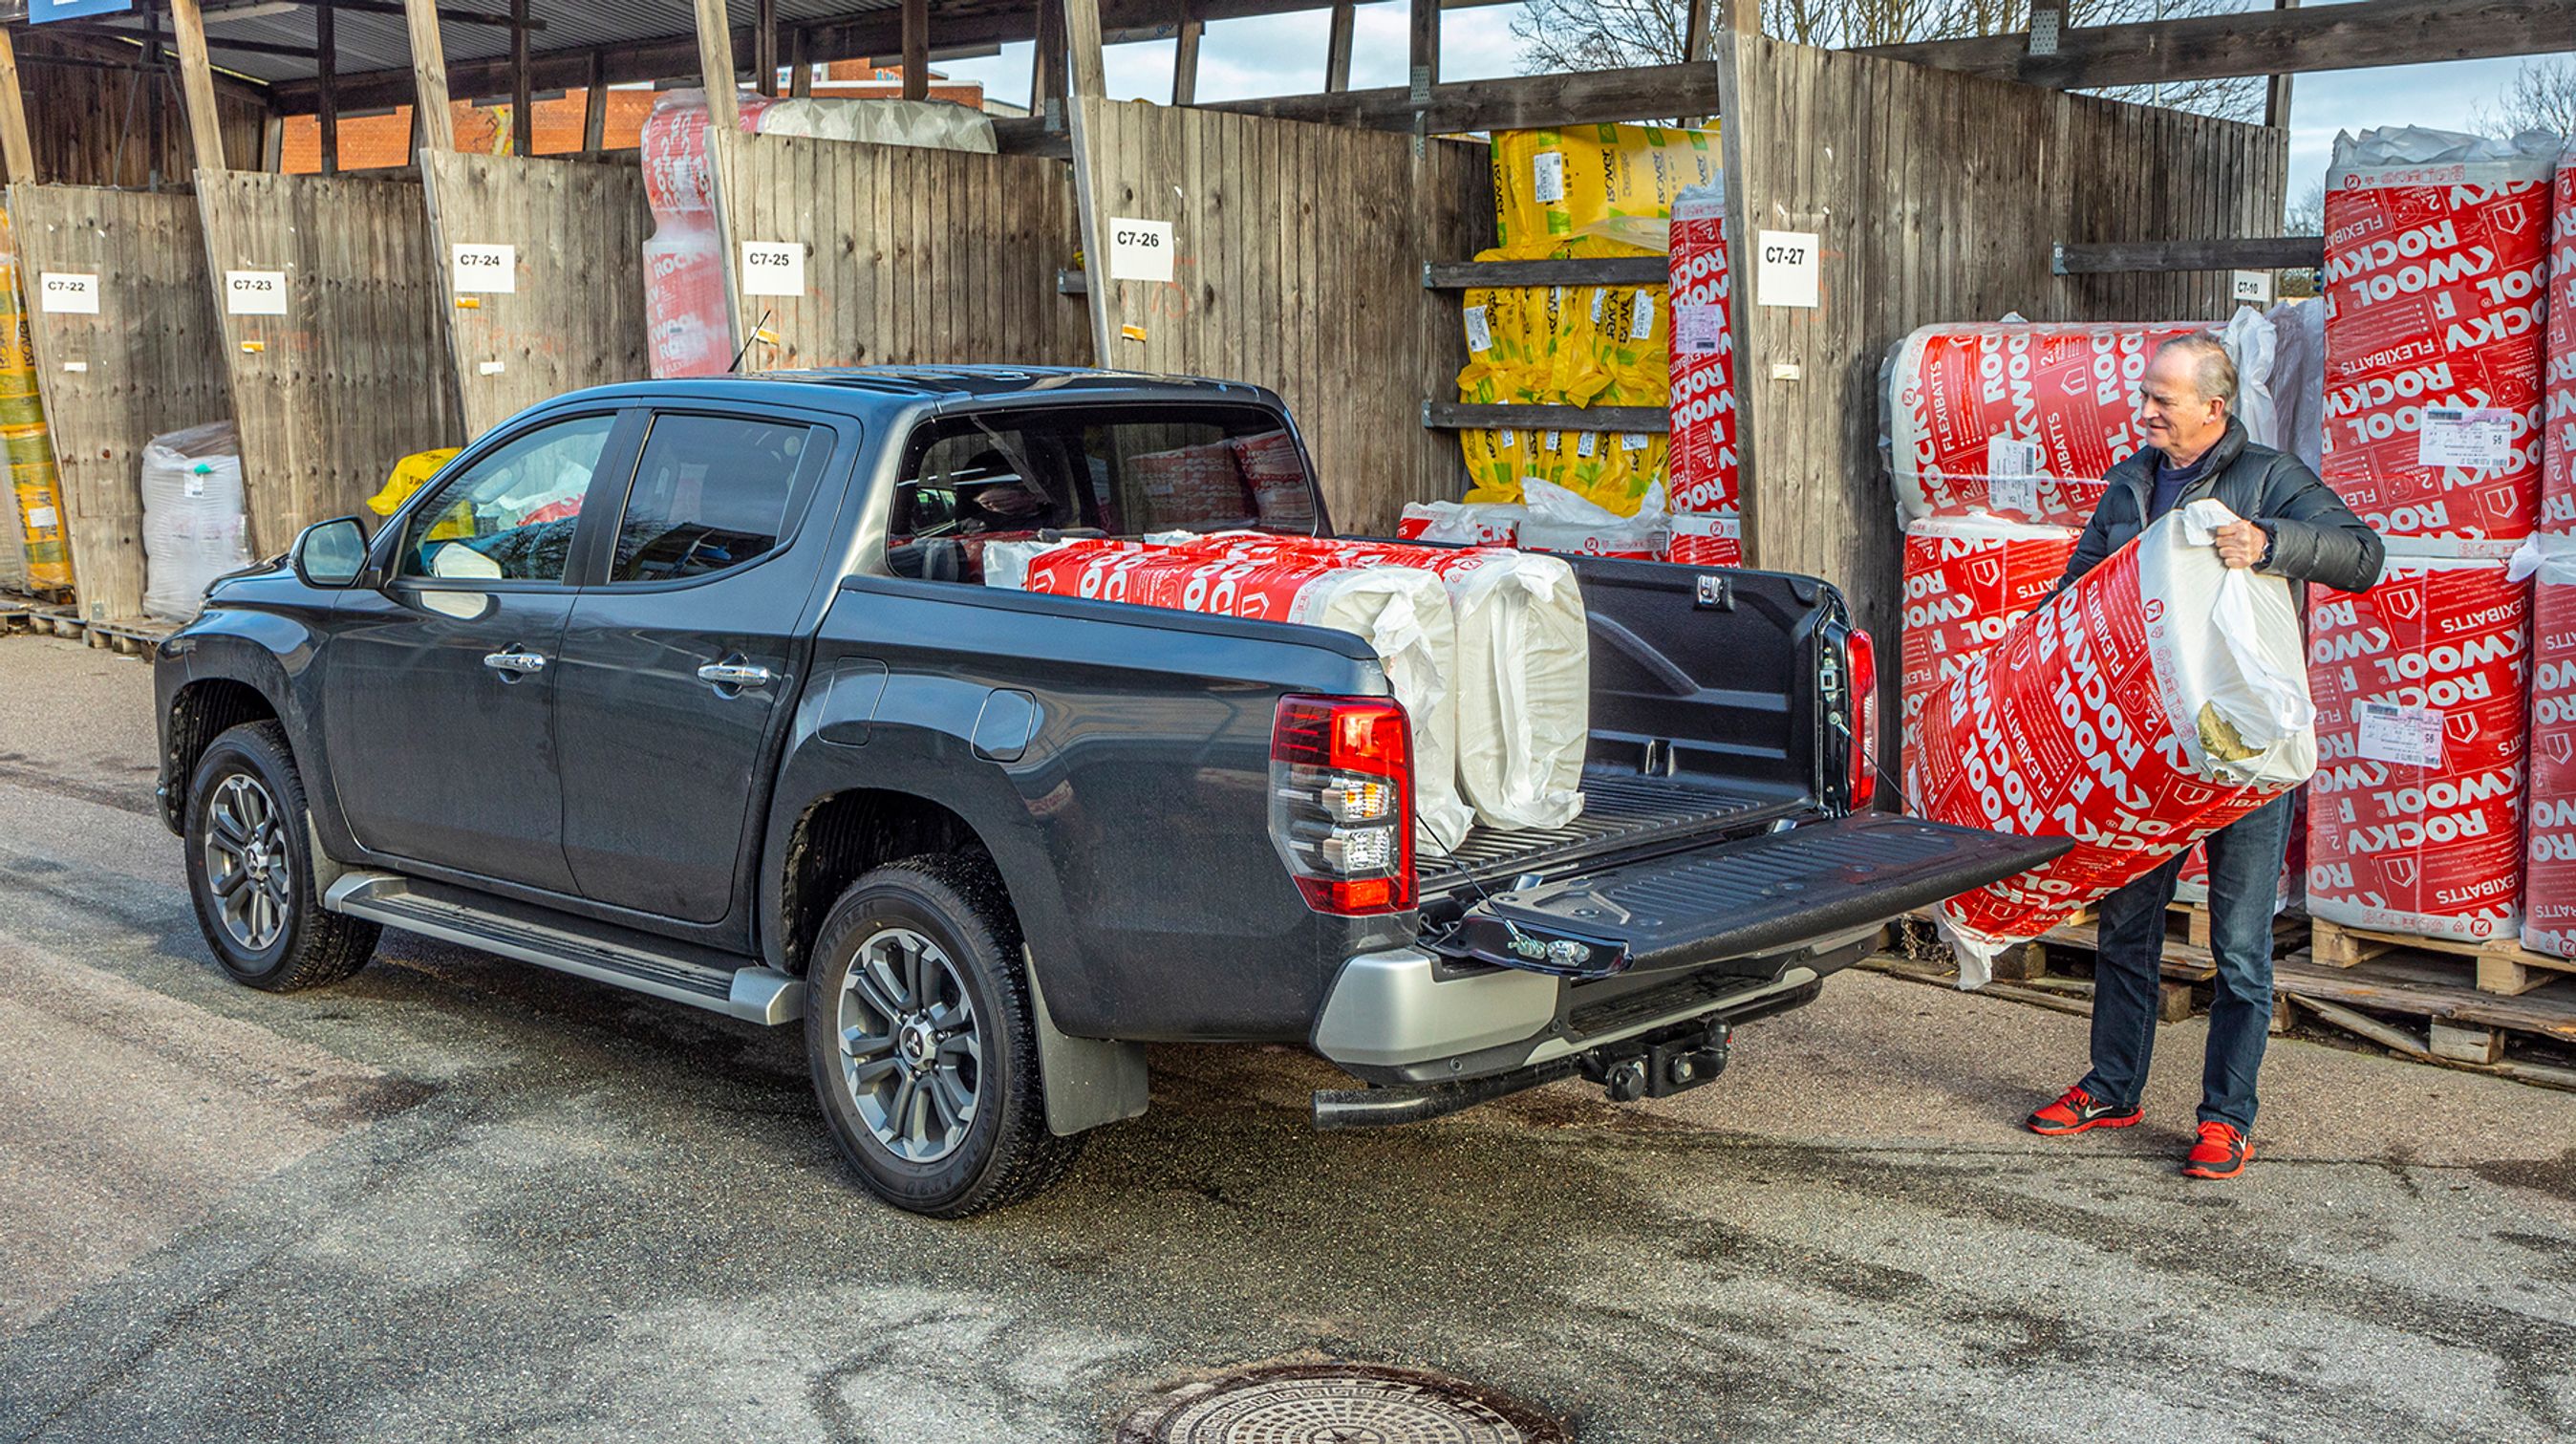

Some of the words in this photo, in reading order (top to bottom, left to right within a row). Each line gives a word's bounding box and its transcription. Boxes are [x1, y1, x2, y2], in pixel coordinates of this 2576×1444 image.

[1117, 230, 1159, 248] C7-26
[1766, 246, 1805, 265] C7-27
[461, 254, 500, 267] C7-24
[749, 252, 789, 267] C7-25
[48, 281, 85, 291] C7-22
[233, 280, 272, 291] C7-23
[2341, 338, 2435, 376] FLEXIBATTS
[1669, 363, 1726, 408] ROCK
[1672, 389, 1735, 432] WOOL
[1930, 360, 1956, 452] FLEXIBATTS
[2047, 412, 2086, 504] FLEXIBATTS
[2086, 580, 2124, 678] FLEXIBATTS
[2002, 697, 2053, 800] FLEXIBATTS
